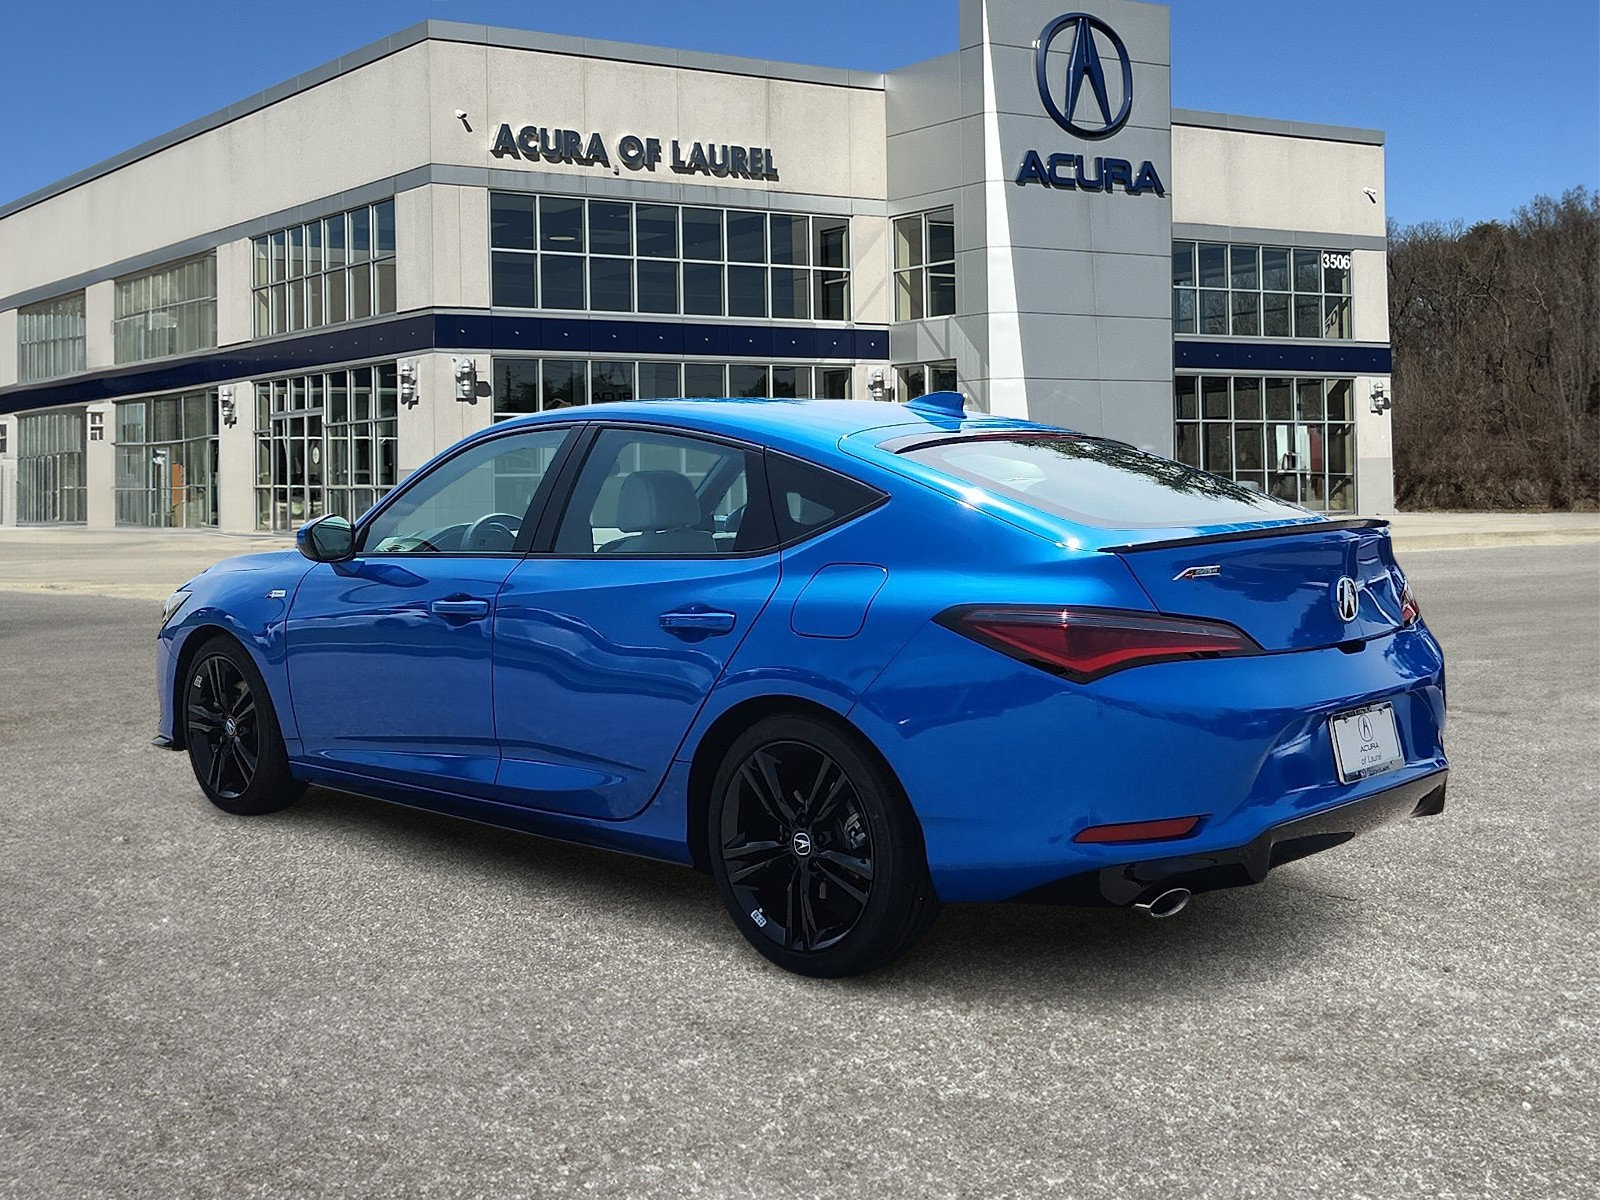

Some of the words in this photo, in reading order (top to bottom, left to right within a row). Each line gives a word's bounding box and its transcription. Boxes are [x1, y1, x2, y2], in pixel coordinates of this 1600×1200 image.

[491, 123, 610, 168] ACURA
[618, 135, 662, 171] OF
[671, 140, 779, 181] LAUREL
[1016, 149, 1165, 198] ACURA
[1322, 253, 1350, 270] 3506
[1360, 742, 1379, 752] ACURA
